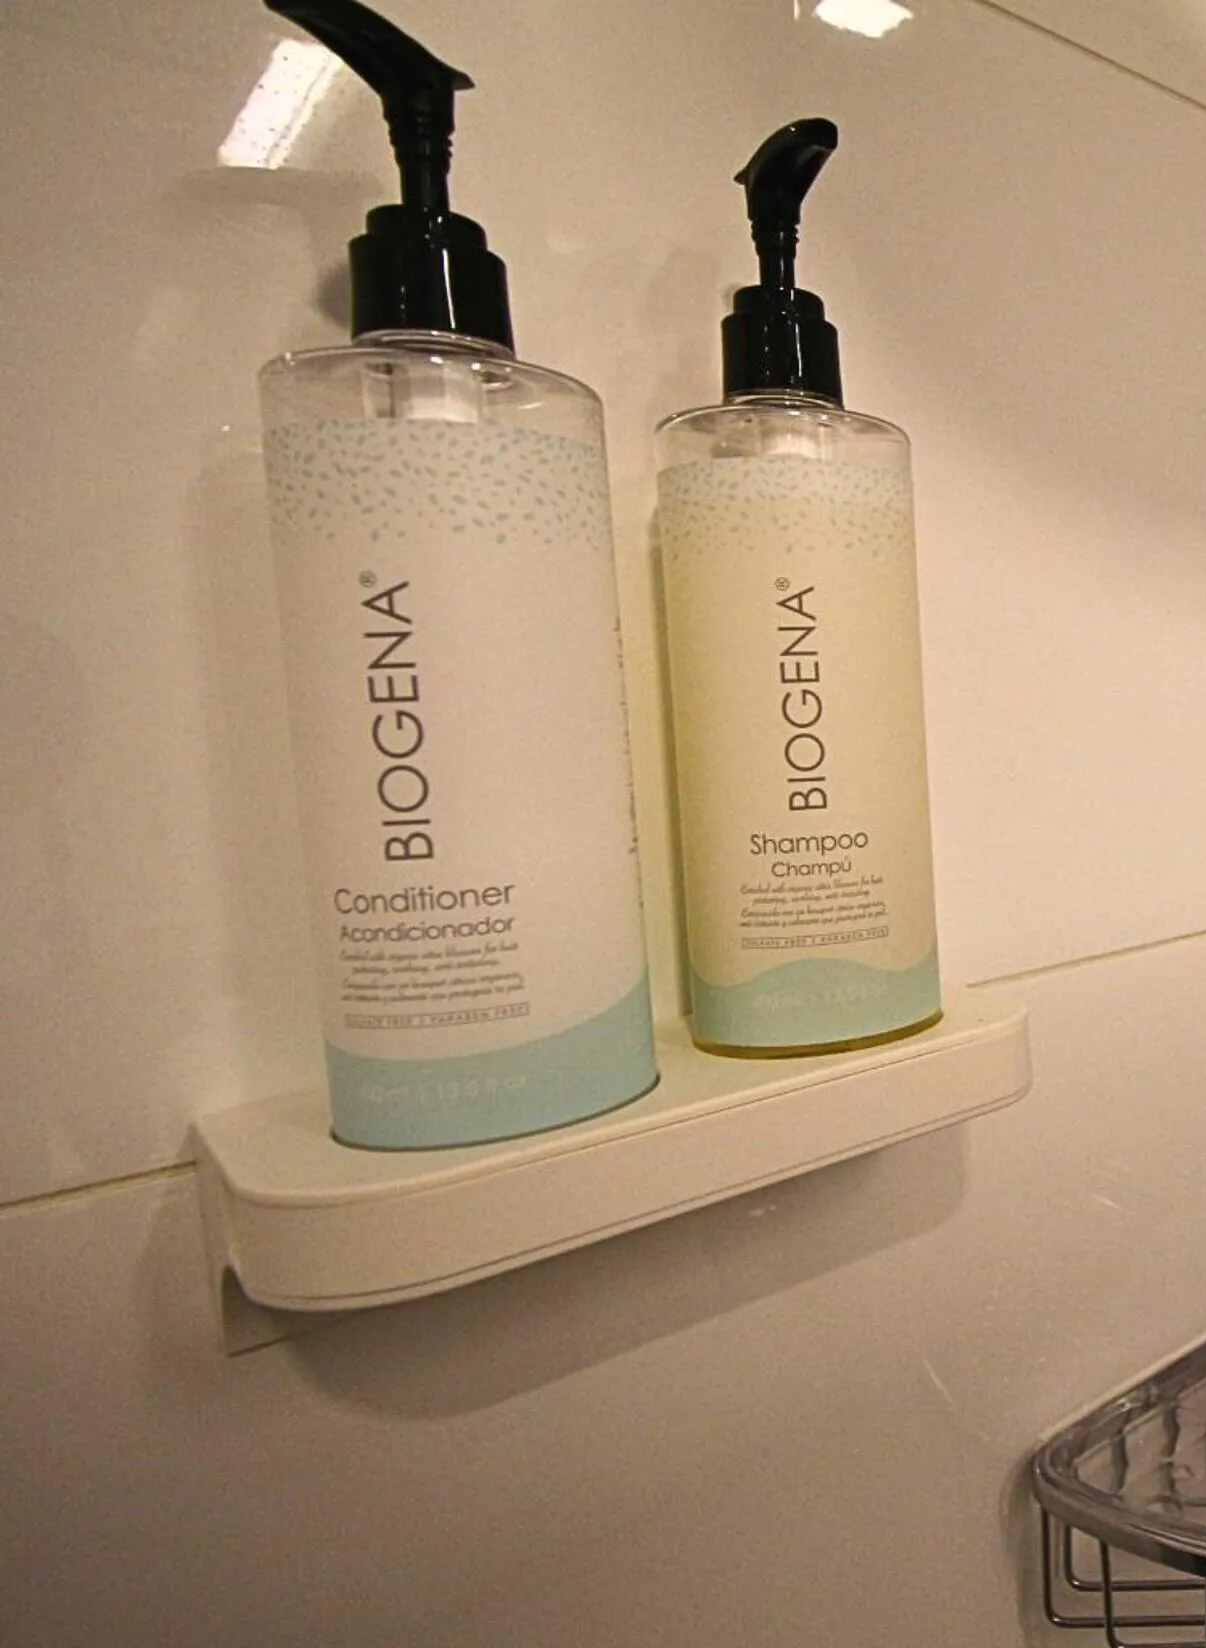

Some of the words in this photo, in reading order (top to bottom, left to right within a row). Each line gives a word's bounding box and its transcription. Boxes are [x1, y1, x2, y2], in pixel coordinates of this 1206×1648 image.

[775, 585, 828, 811] BIOGENA
[360, 580, 435, 861] BIOGENA
[750, 832, 869, 856] Shampoo
[771, 856, 852, 877] Champú
[333, 884, 516, 914] Conditioner
[339, 916, 515, 943] Acondicionador
